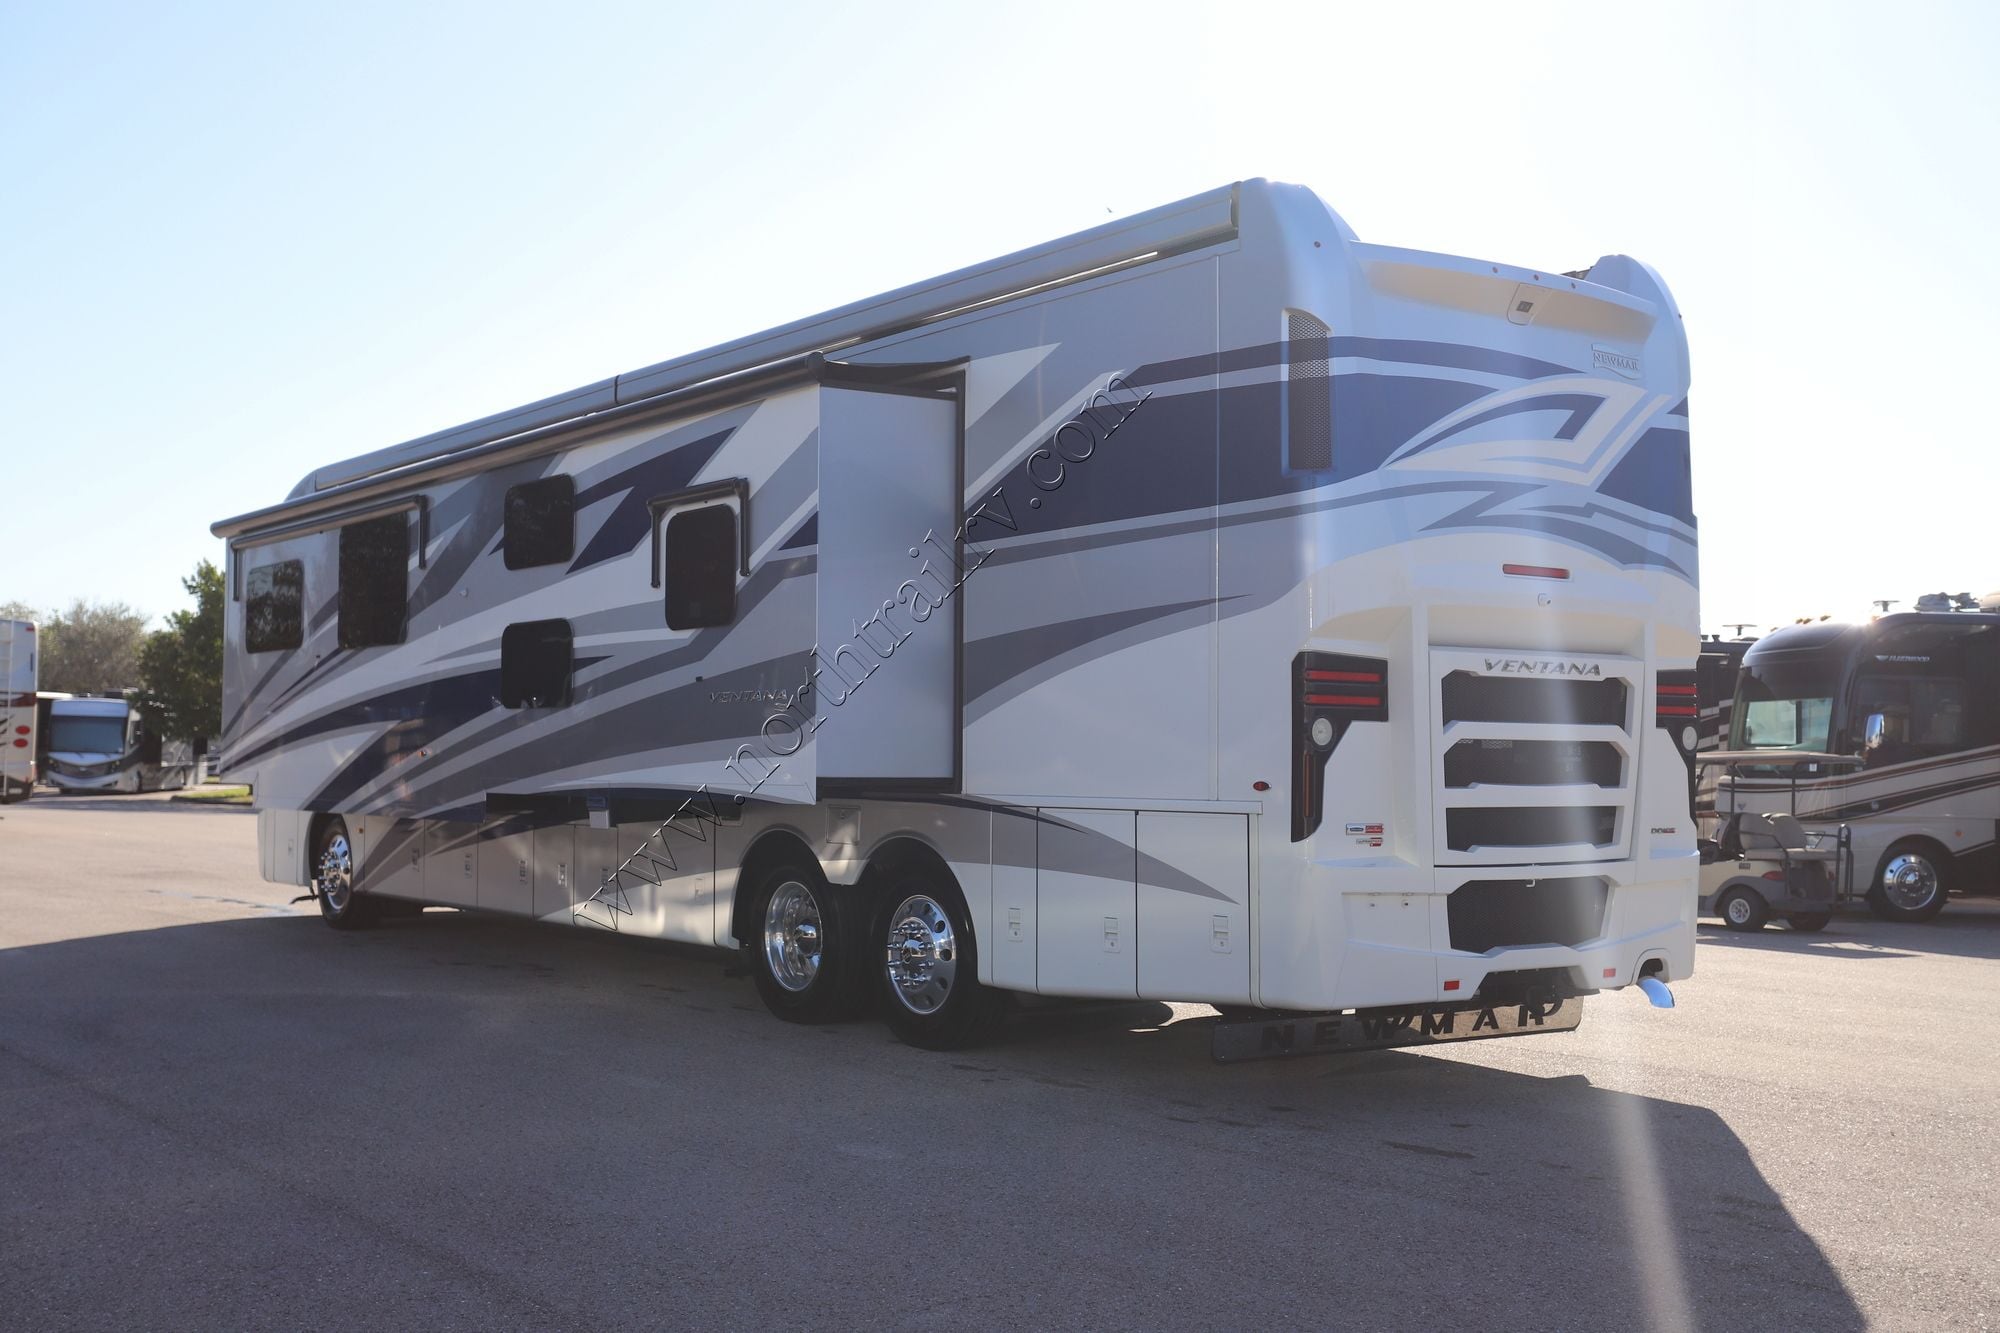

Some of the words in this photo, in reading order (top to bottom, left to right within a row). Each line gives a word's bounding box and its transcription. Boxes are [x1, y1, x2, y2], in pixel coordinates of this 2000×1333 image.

[1592, 351, 1640, 371] NEWMAR
[1484, 657, 1601, 676] VENTANA
[710, 688, 788, 704] VENTANA
[1261, 1003, 1545, 1049] NEWMAR
